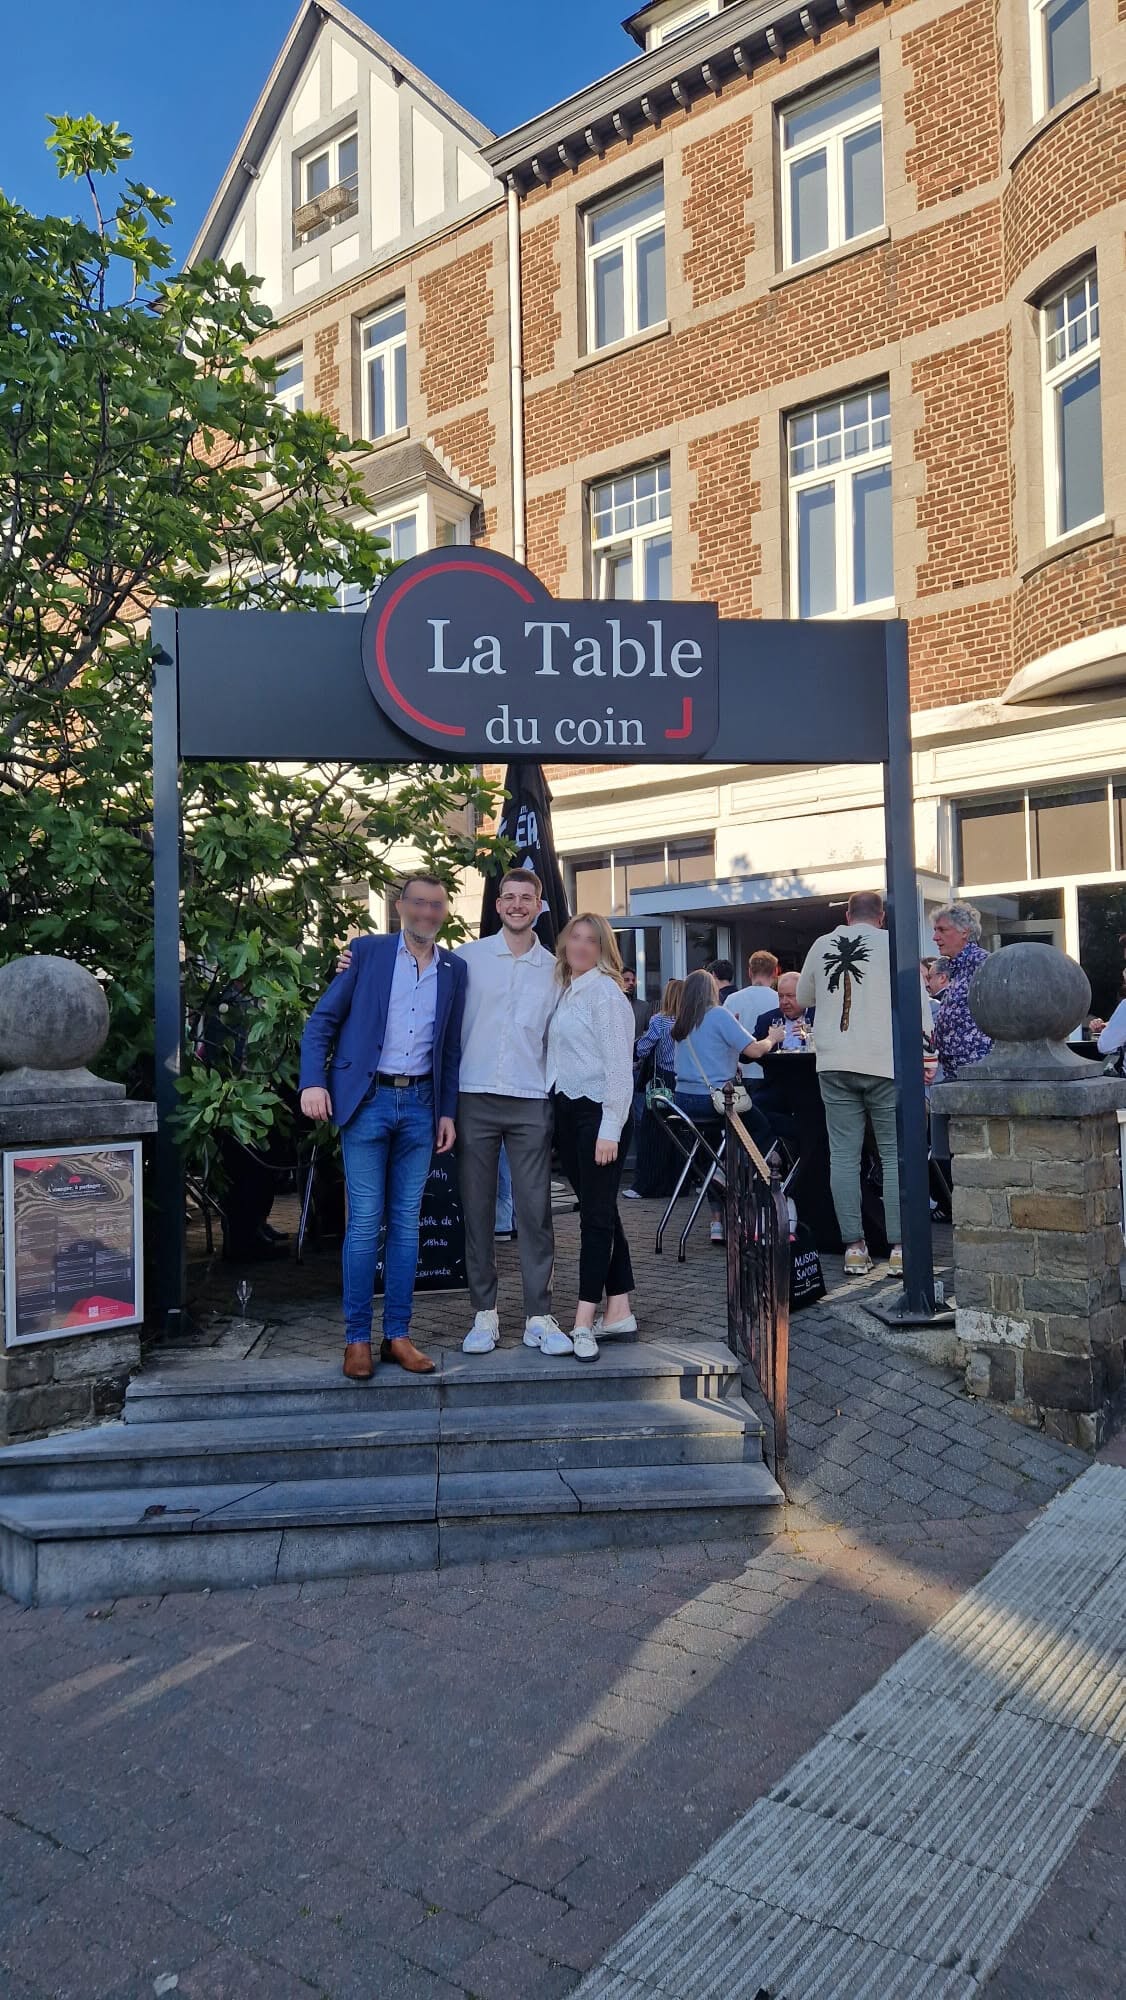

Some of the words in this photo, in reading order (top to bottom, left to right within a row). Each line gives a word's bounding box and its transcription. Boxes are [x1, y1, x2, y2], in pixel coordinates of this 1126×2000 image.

[426, 619, 507, 675] La
[524, 619, 703, 678] Table
[485, 705, 541, 745] du
[555, 707, 646, 746] coin
